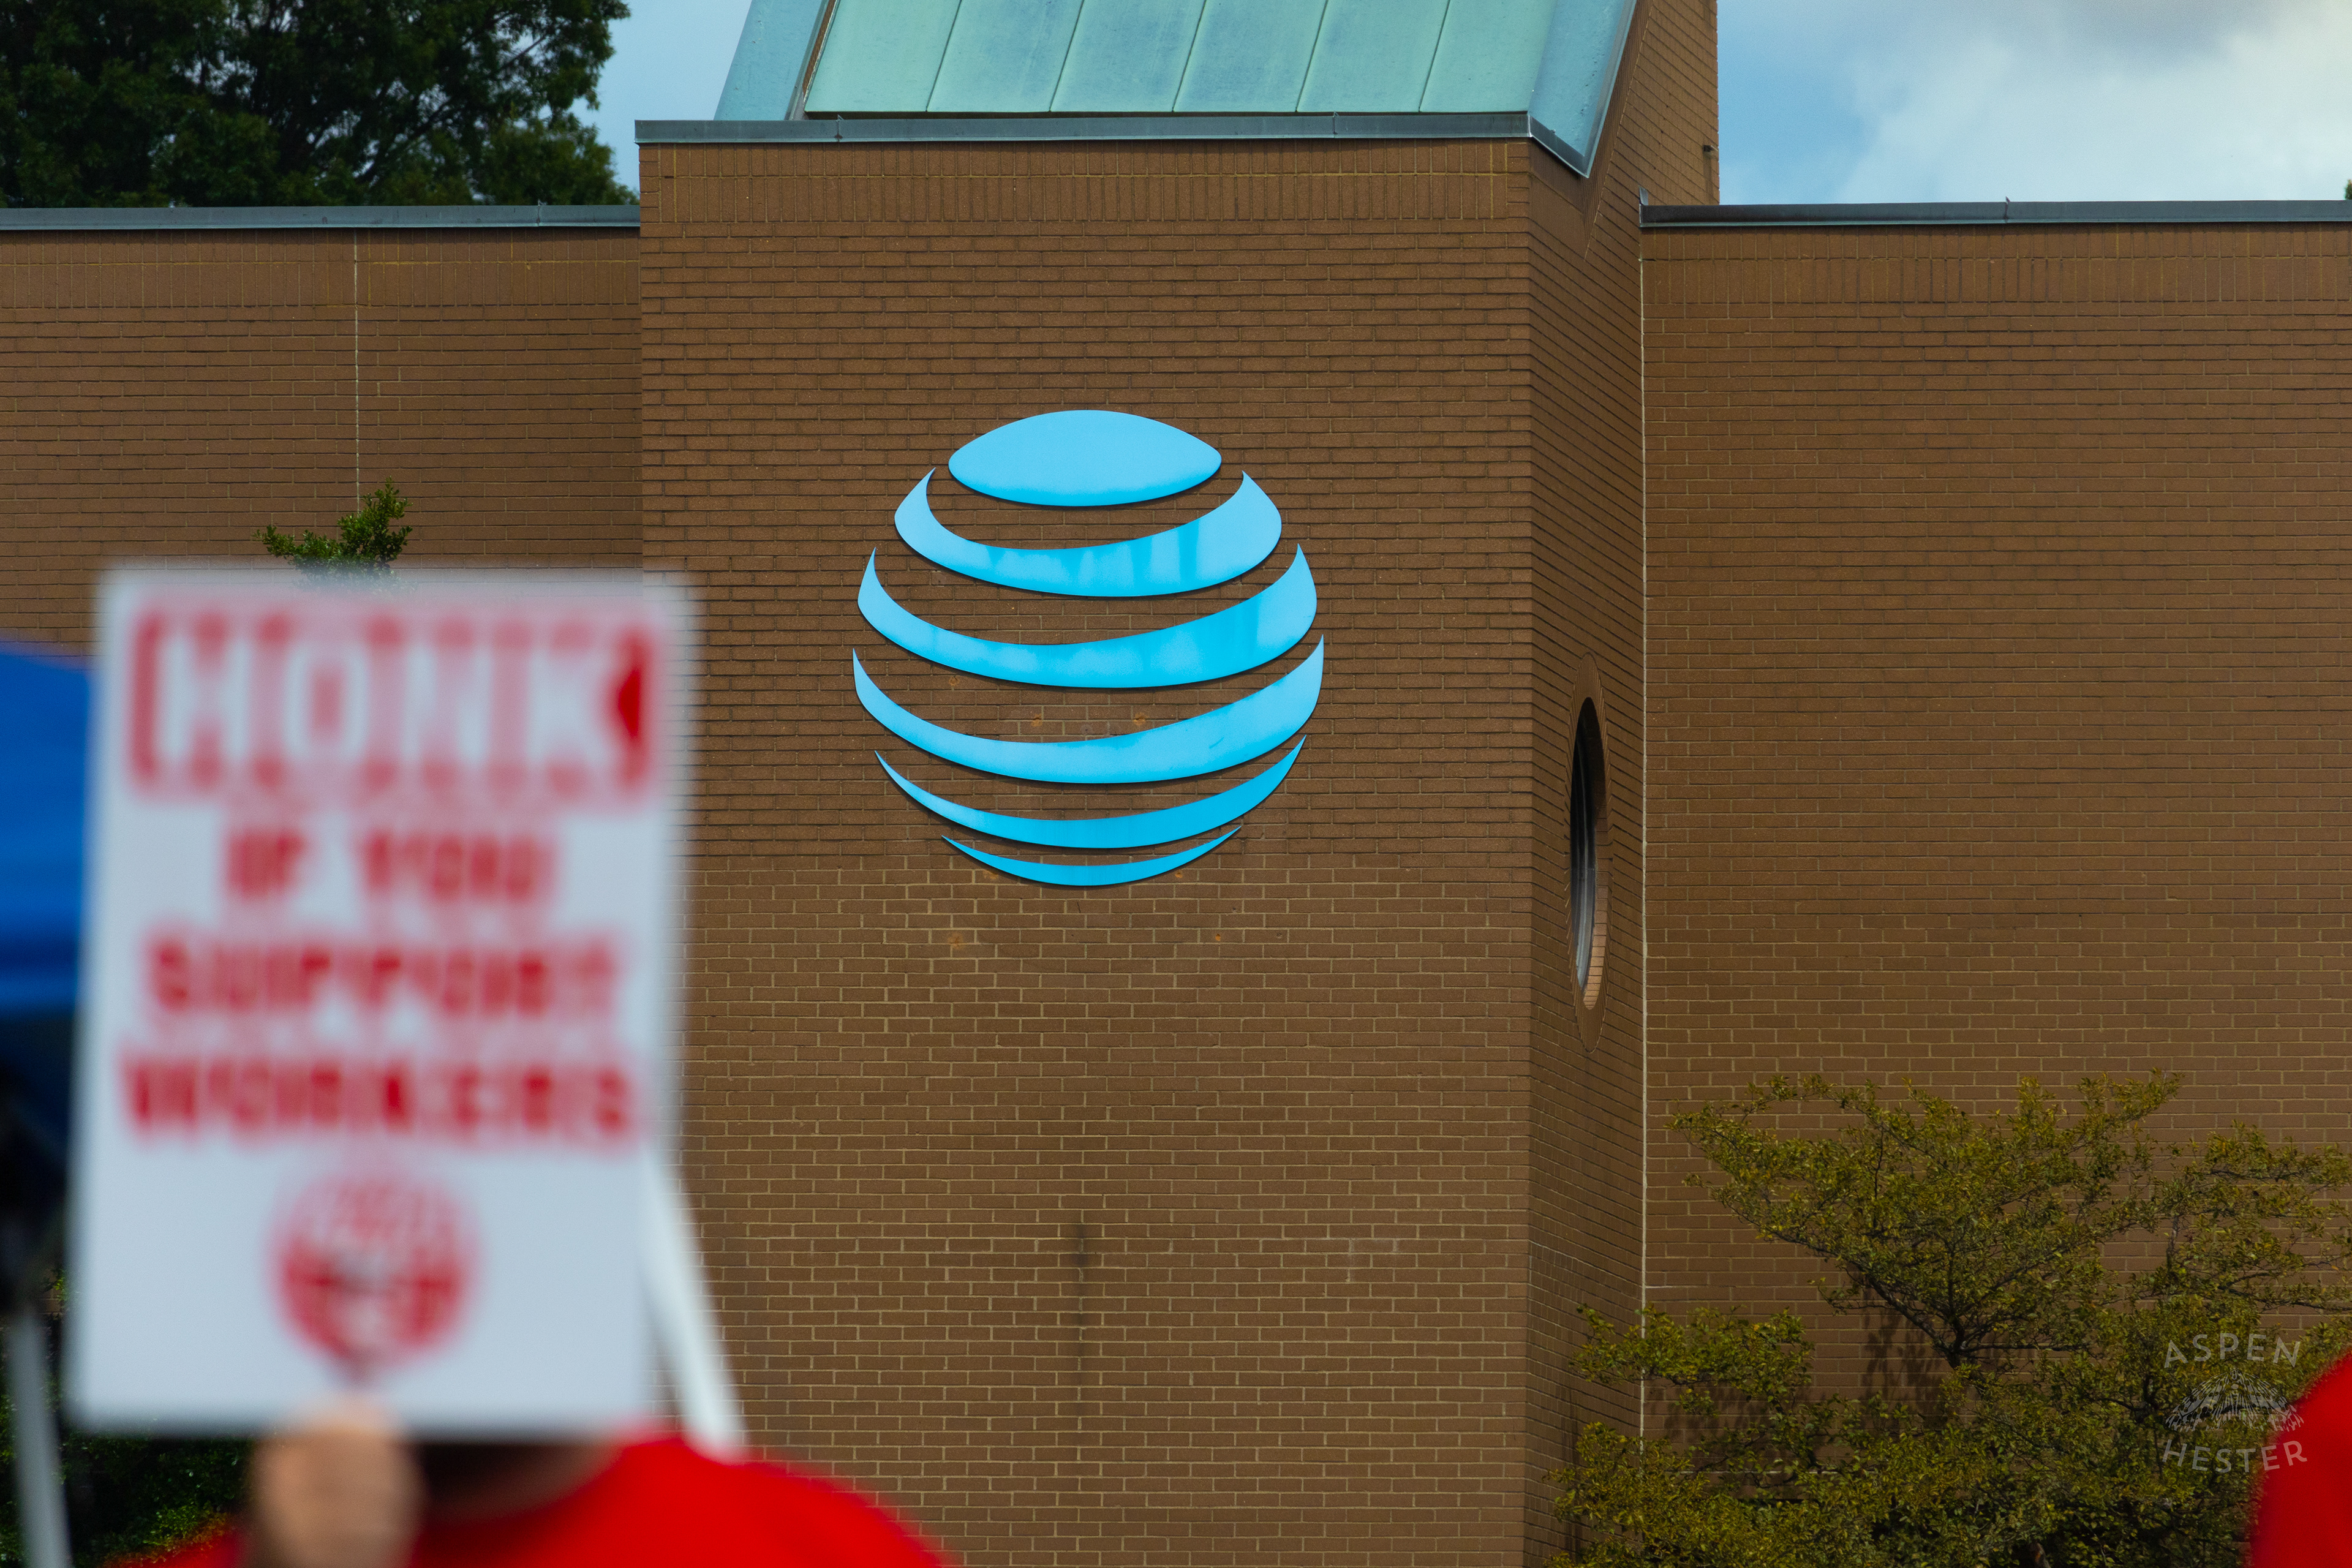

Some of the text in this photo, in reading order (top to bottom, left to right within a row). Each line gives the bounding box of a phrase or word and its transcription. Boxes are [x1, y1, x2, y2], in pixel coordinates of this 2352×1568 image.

[150, 614, 626, 796] HONK
[222, 826, 559, 909] IF YOU
[145, 935, 622, 1018] SUPPORT
[124, 1056, 641, 1142] WORKERS
